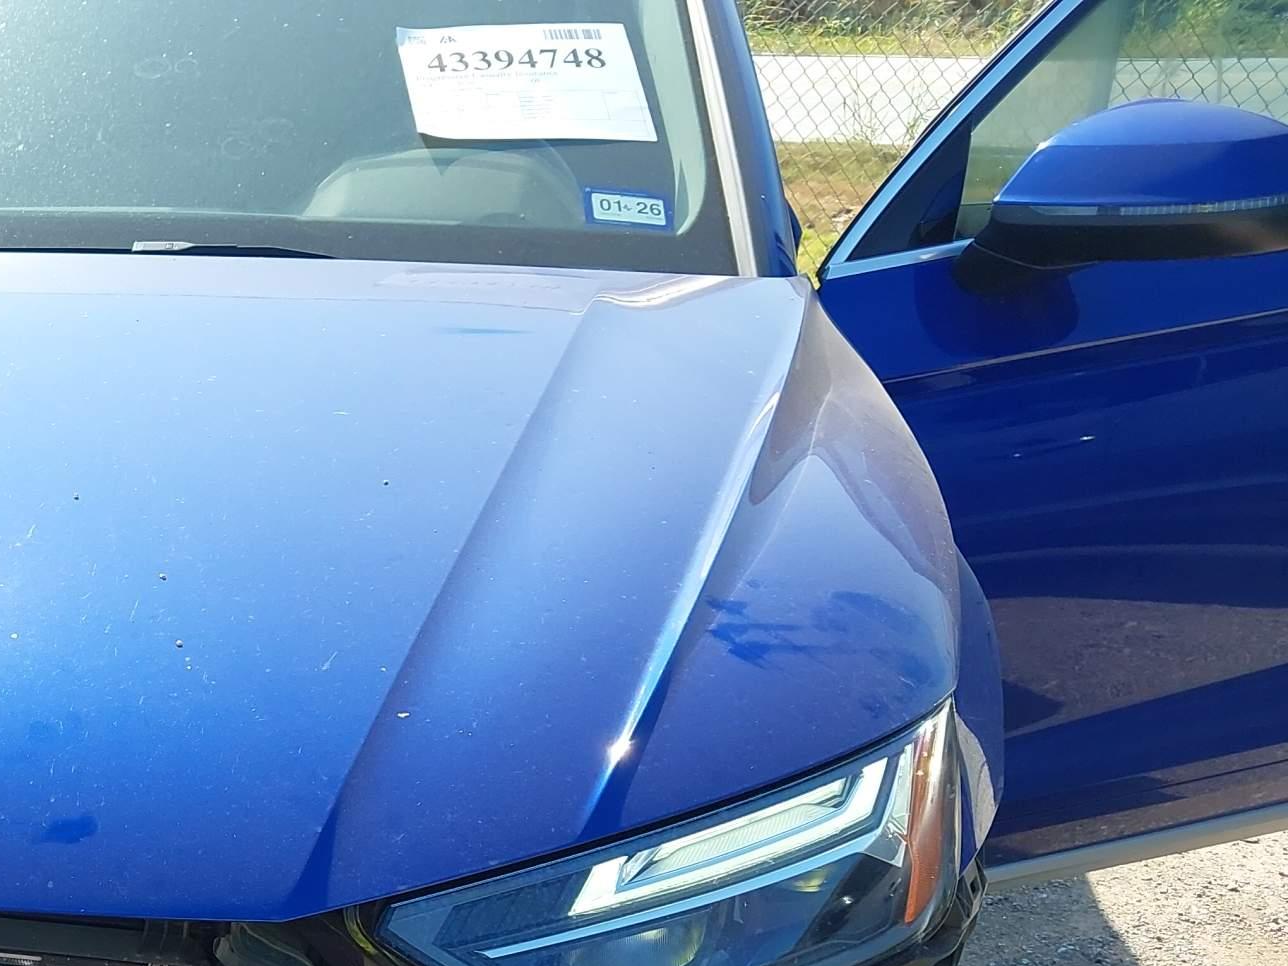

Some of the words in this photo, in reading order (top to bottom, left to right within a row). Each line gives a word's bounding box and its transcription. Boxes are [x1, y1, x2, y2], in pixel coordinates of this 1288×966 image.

[427, 48, 607, 73] 43394748
[600, 198, 622, 212] 01
[636, 201, 662, 216] 26
